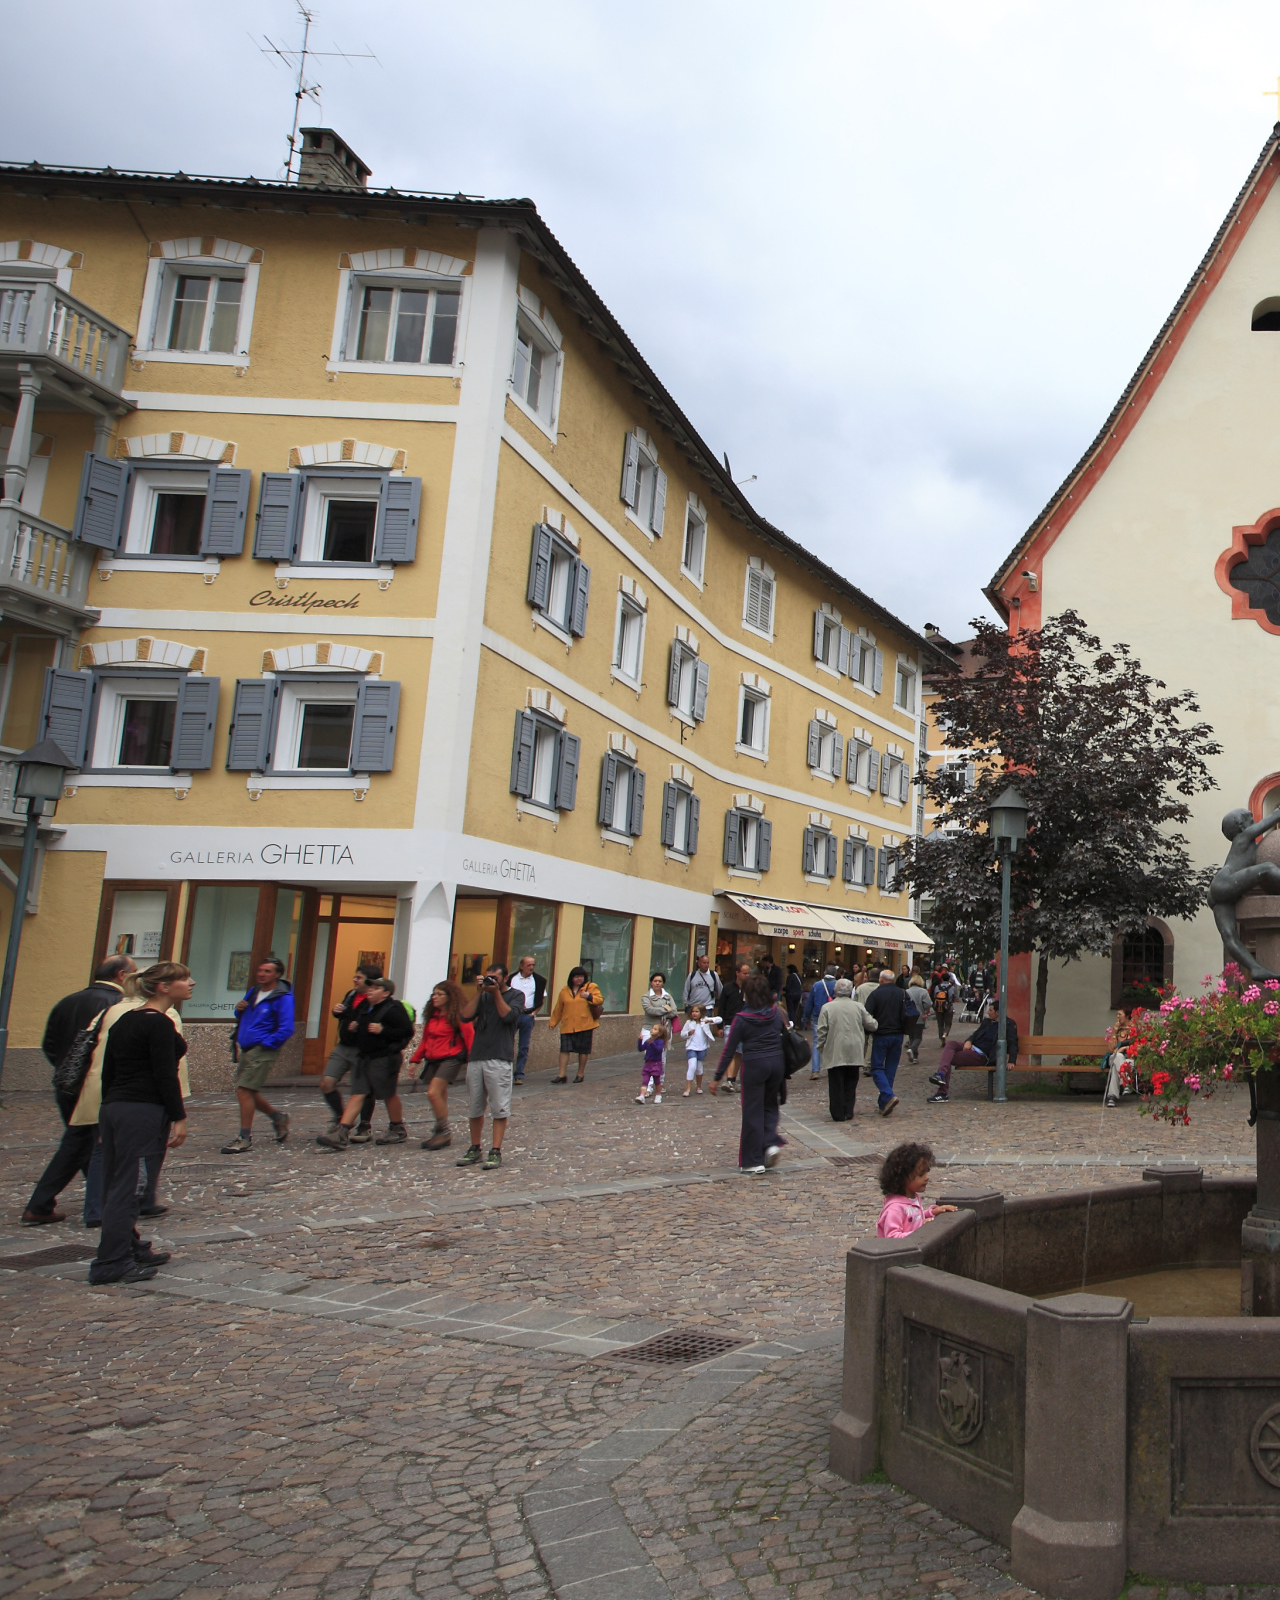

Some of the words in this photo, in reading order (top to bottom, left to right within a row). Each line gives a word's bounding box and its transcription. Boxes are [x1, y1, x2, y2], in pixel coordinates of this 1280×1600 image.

[249, 590, 360, 613] Cristlpech
[170, 851, 254, 864] GALLERIA
[260, 843, 354, 865] GHETTA
[462, 859, 498, 876] GALLERIA
[500, 859, 535, 882] GHETTA
[792, 929, 804, 937] sport
[210, 1003, 236, 1011] GHETT
